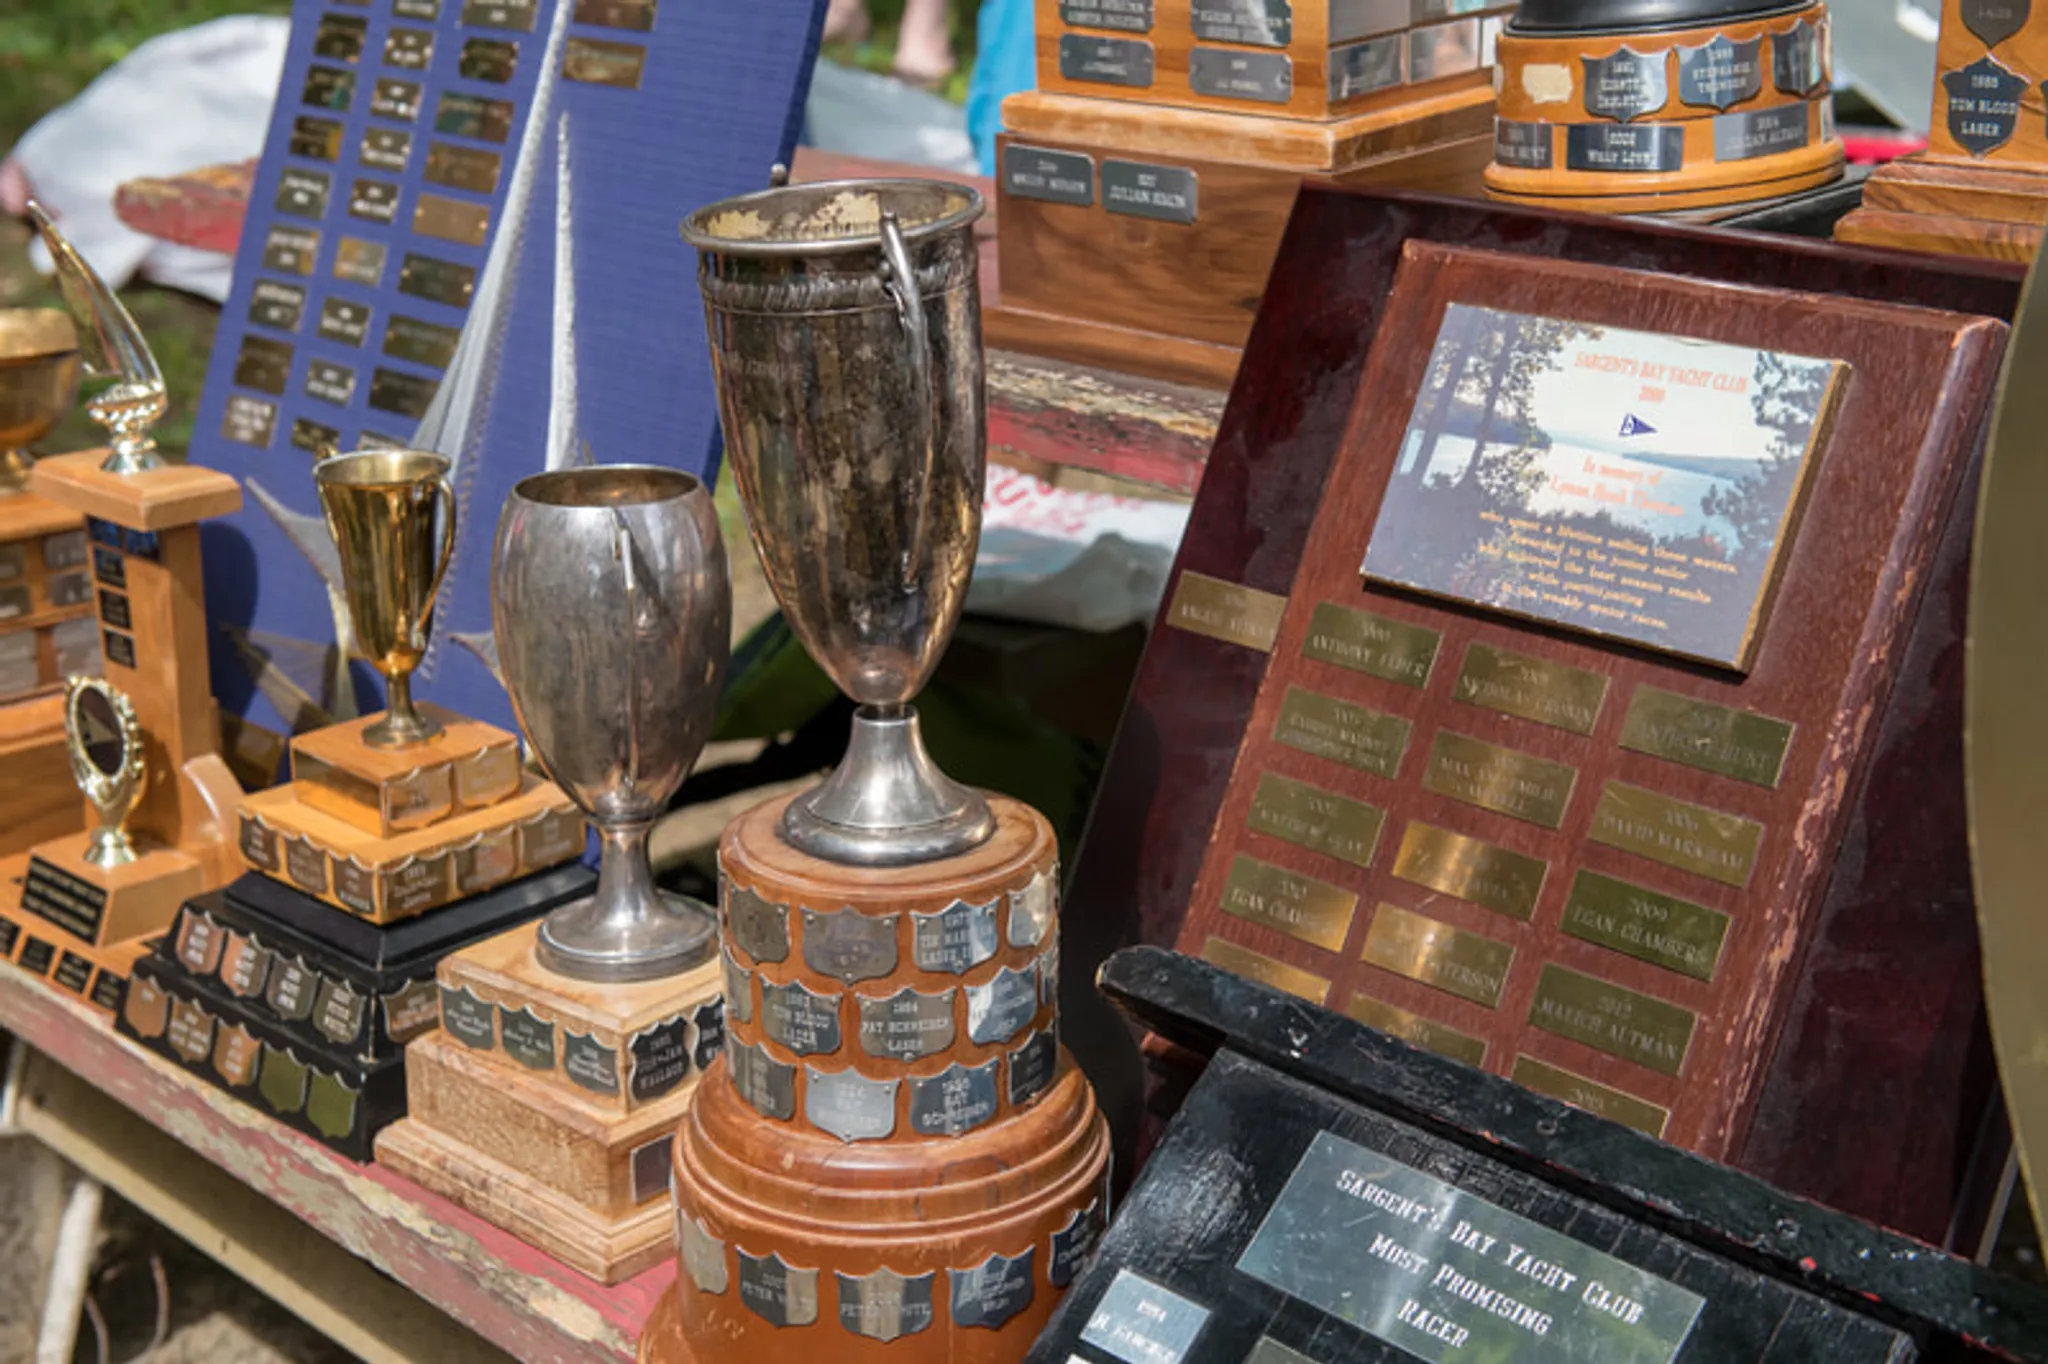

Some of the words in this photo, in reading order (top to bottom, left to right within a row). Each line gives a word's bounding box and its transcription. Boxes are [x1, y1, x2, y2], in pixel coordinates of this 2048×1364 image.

[1335, 1168, 1444, 1232] SARGENT'S
[1449, 1219, 1498, 1255] BAY
[1503, 1243, 1578, 1293] YACHT
[1582, 1280, 1645, 1325] CLUB
[1368, 1231, 1430, 1275] MOST
[1432, 1263, 1554, 1336] PROMISING
[1397, 1298, 1470, 1349] RACER
